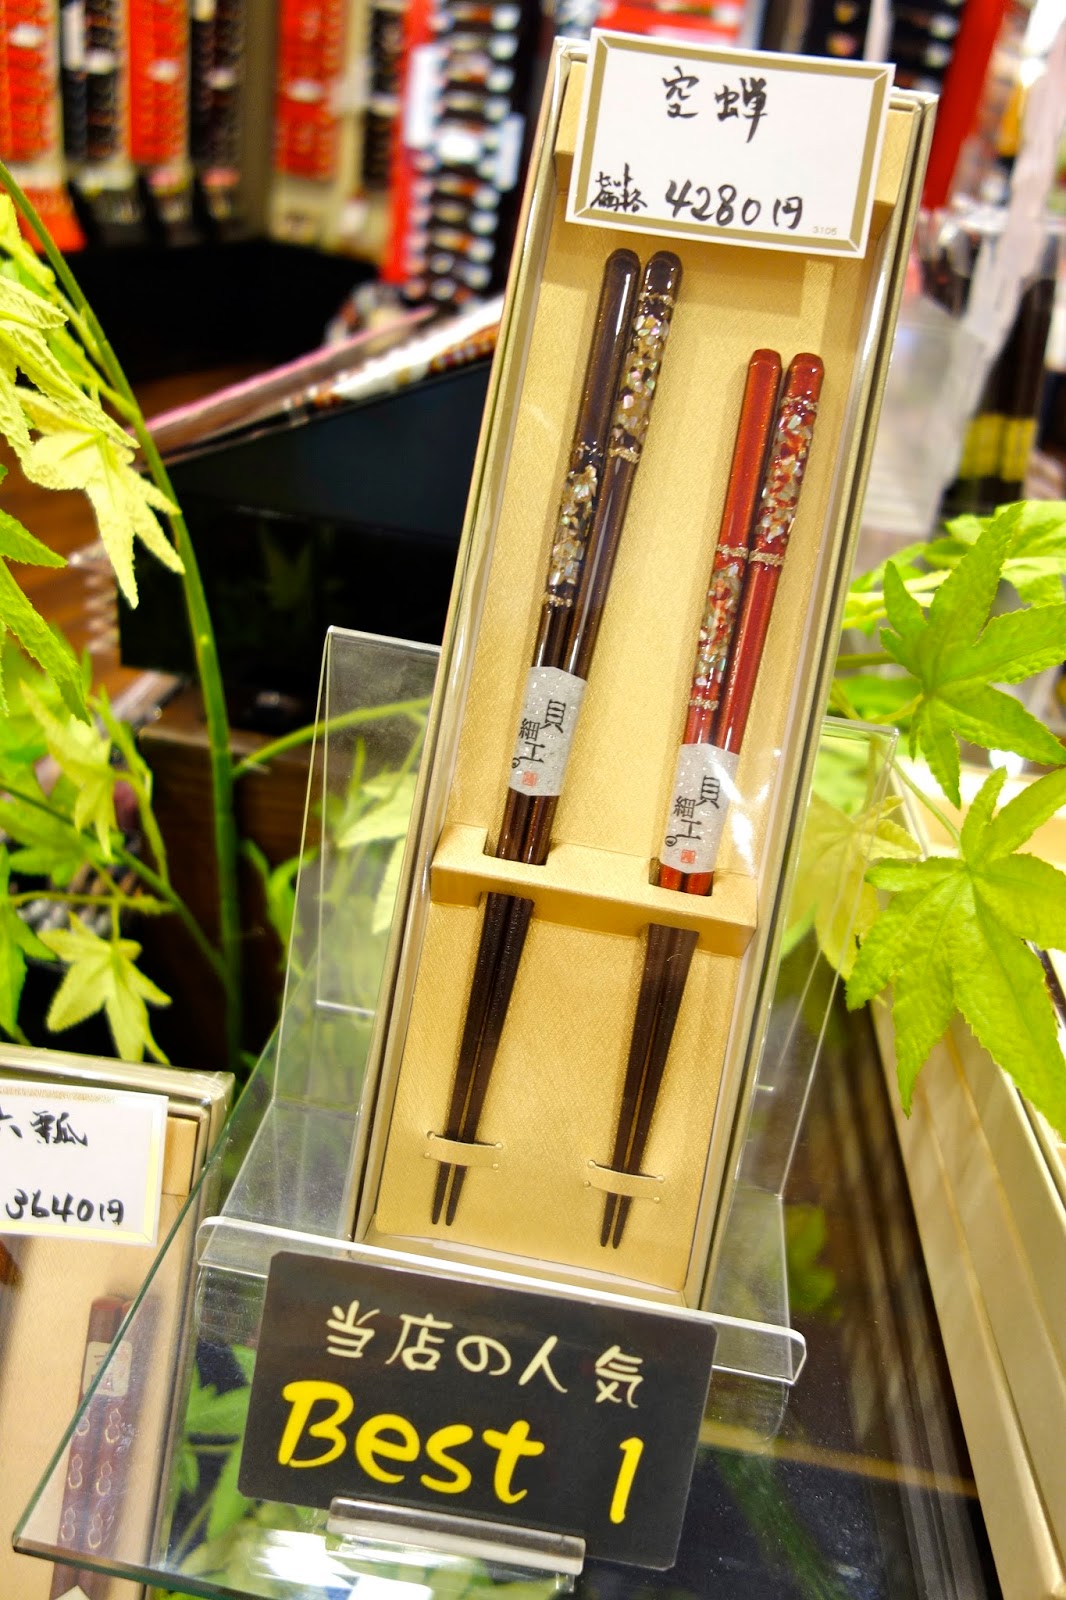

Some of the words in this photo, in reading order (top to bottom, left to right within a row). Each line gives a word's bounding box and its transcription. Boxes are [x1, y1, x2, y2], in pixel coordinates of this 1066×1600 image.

[812, 225, 838, 236] 3105
[325, 1299, 645, 1409] 当店の人気
[277, 1380, 545, 1504] Best
[609, 1436, 645, 1524] 1
